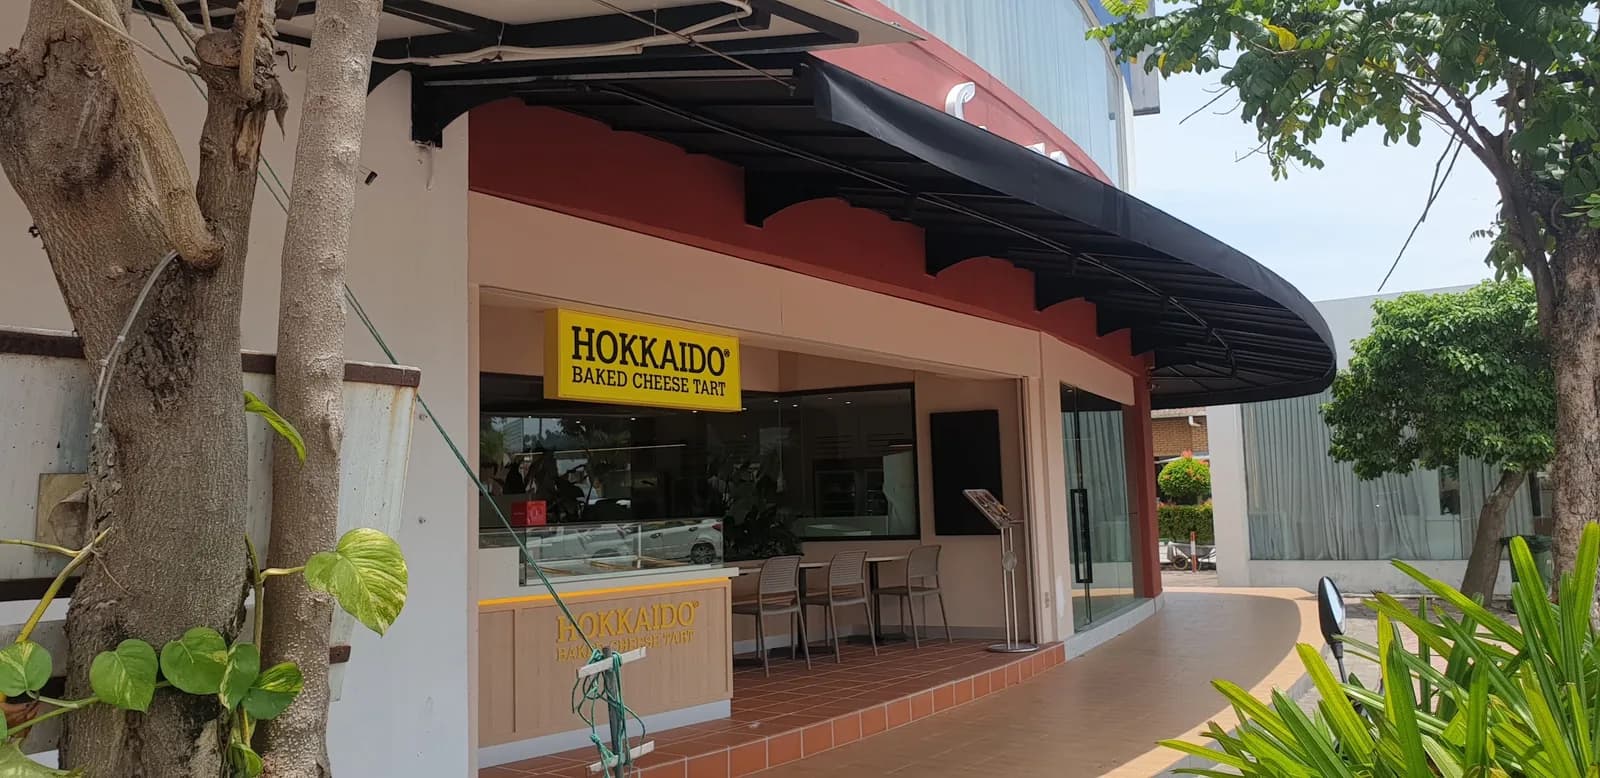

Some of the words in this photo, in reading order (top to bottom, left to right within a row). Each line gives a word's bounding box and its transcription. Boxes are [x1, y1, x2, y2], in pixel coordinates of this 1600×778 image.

[572, 365, 628, 388] BAKED
[632, 372, 689, 393] CHEESE
[693, 379, 726, 397] TART
[556, 642, 603, 662] BAK
[661, 630, 696, 646] TART
